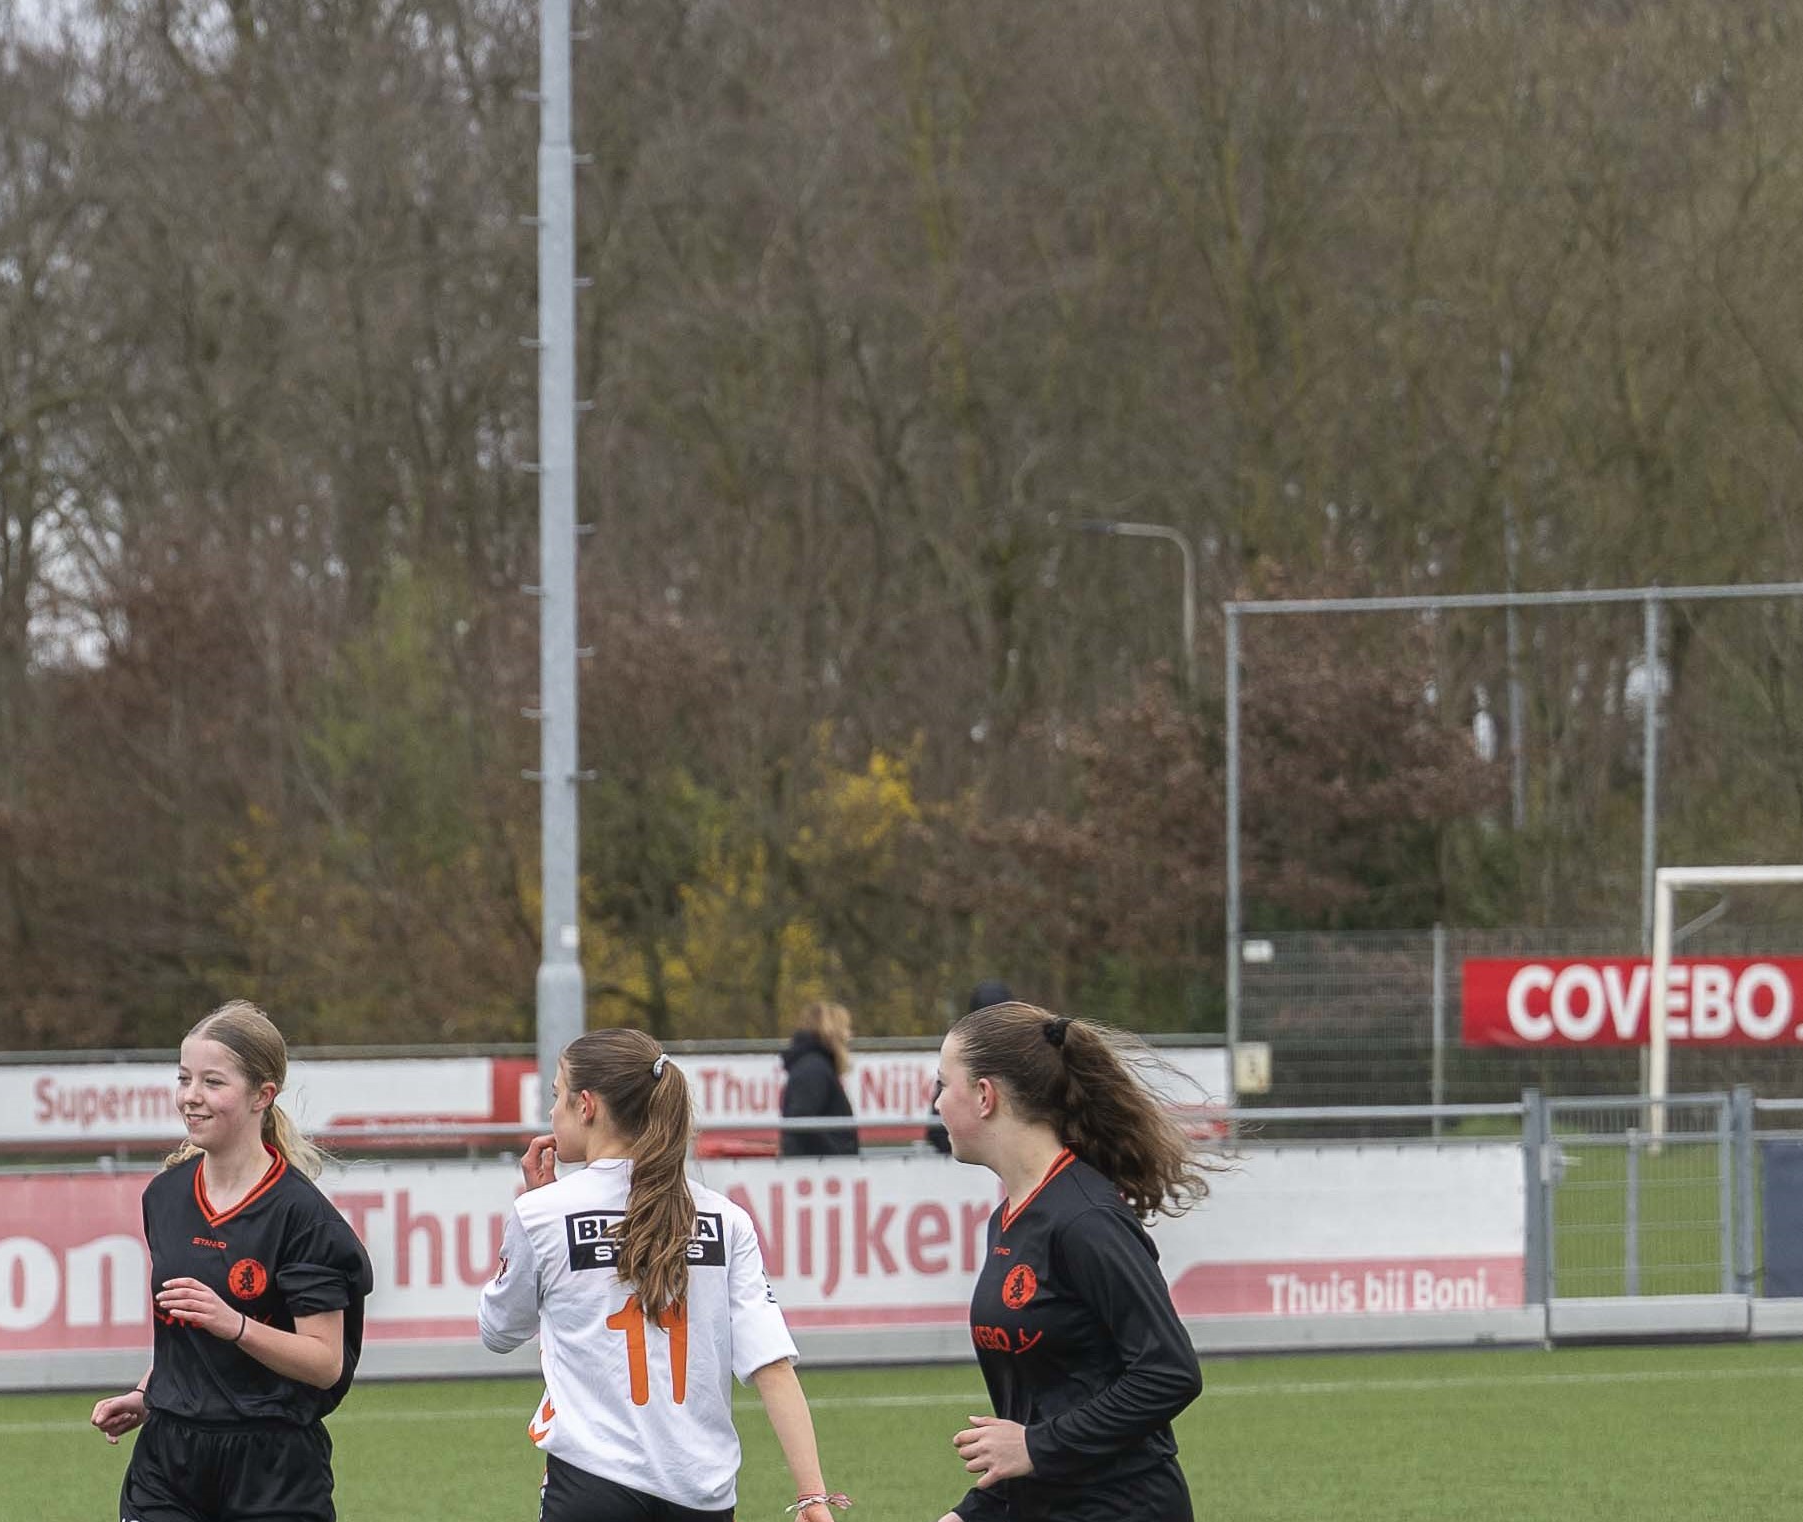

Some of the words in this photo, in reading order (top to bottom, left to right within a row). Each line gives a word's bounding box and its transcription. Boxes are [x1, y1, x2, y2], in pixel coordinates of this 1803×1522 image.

[1506, 963, 1793, 1042] COVEBO
[34, 1076, 178, 1130] Superm
[698, 1067, 783, 1114] Thui
[860, 1064, 935, 1116] Nijk
[726, 1178, 991, 1298] Nijker
[1266, 1271, 1356, 1316] Thuis
[1412, 1267, 1497, 1312] Boni.
[605, 1295, 689, 1406] 11
